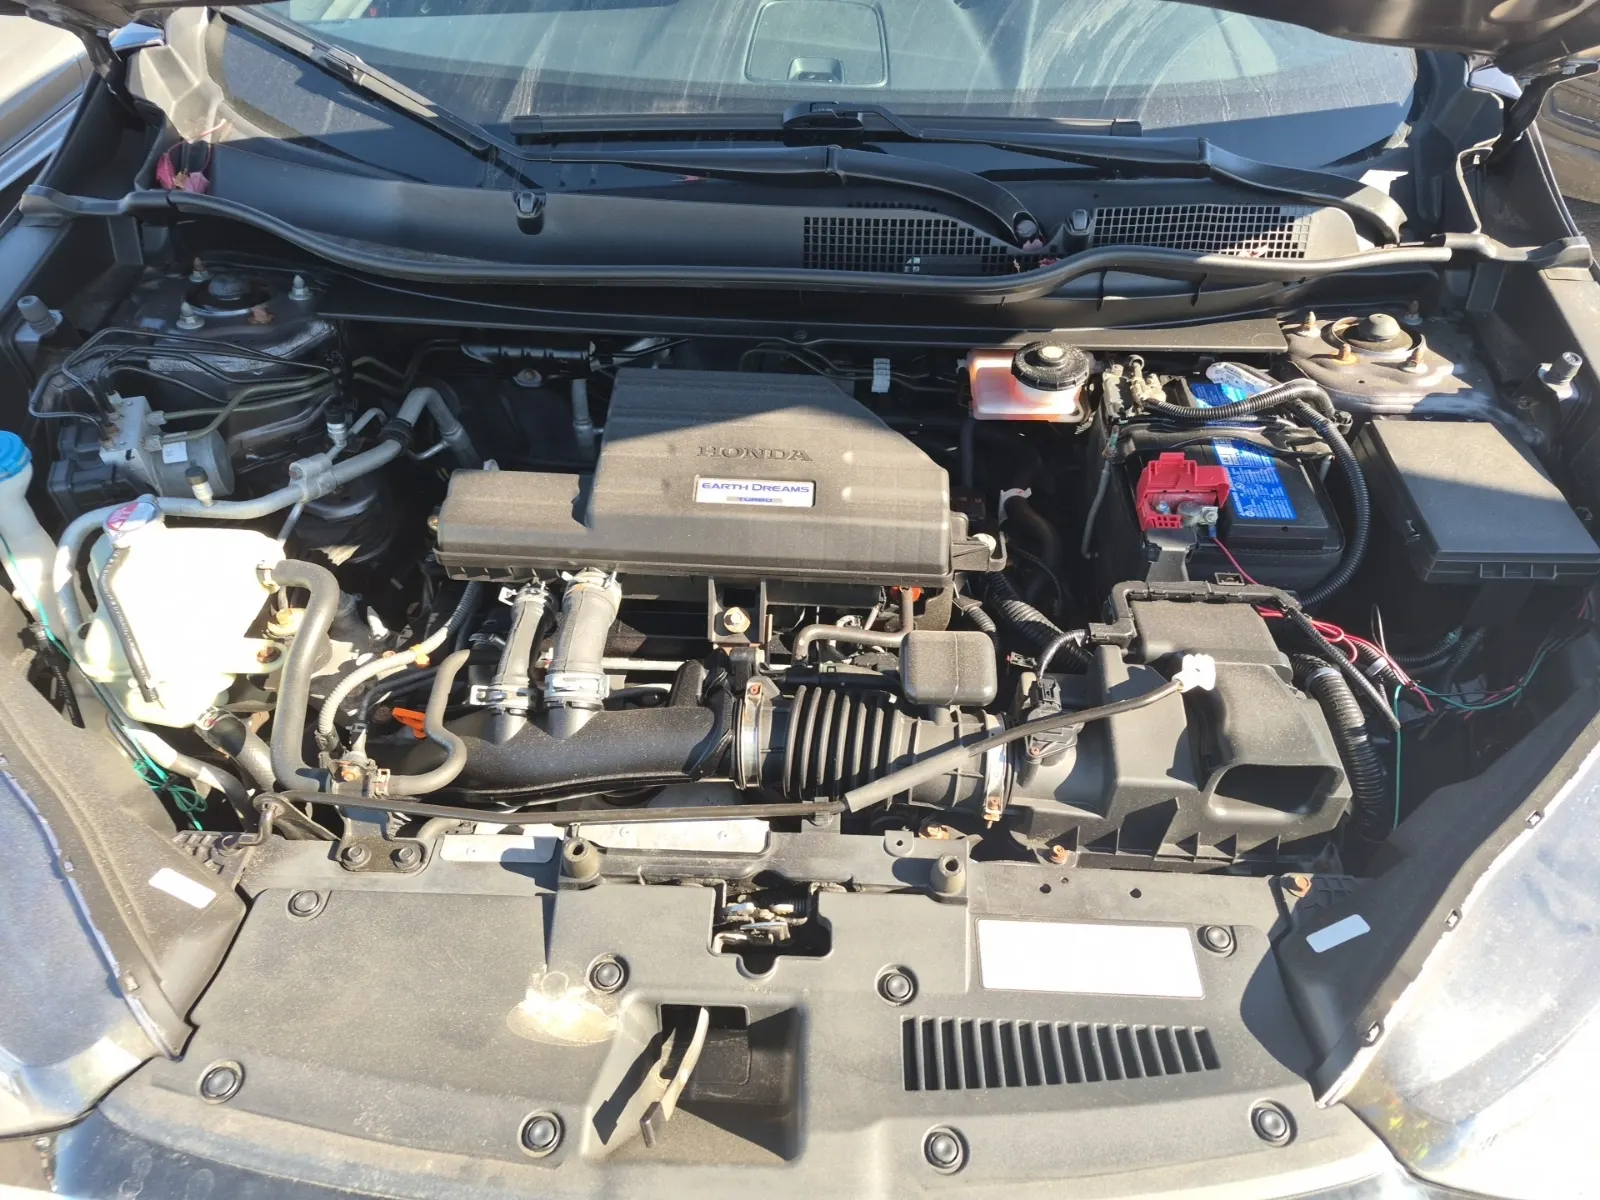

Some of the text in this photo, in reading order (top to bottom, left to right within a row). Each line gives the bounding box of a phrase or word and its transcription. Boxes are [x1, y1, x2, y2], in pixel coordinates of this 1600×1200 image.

[697, 445, 813, 461] HONDA
[702, 482, 810, 493] EARTH DREAMS
